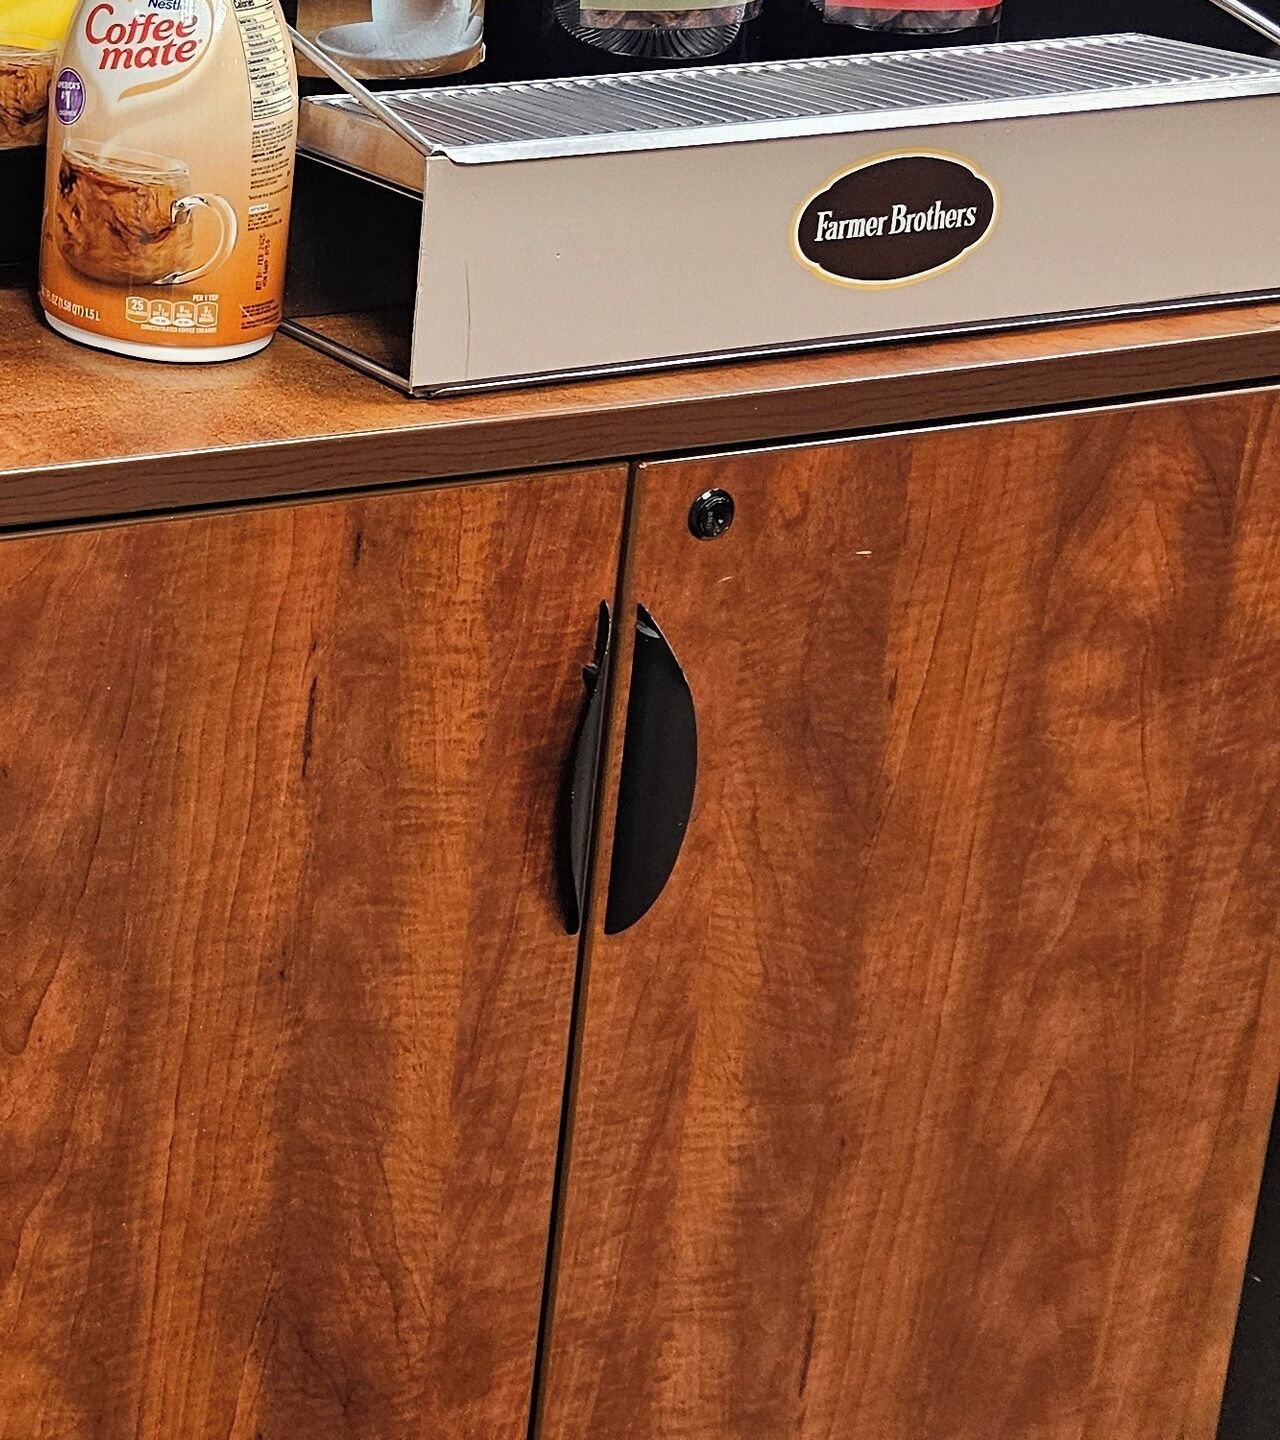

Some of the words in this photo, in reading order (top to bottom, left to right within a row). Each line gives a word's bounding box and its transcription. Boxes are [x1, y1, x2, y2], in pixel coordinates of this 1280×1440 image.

[86, 3, 198, 45] Coffee
[98, 38, 198, 70] mate
[813, 210, 889, 242] Farmer
[888, 200, 978, 236] Brothers
[131, 299, 144, 311] 25
